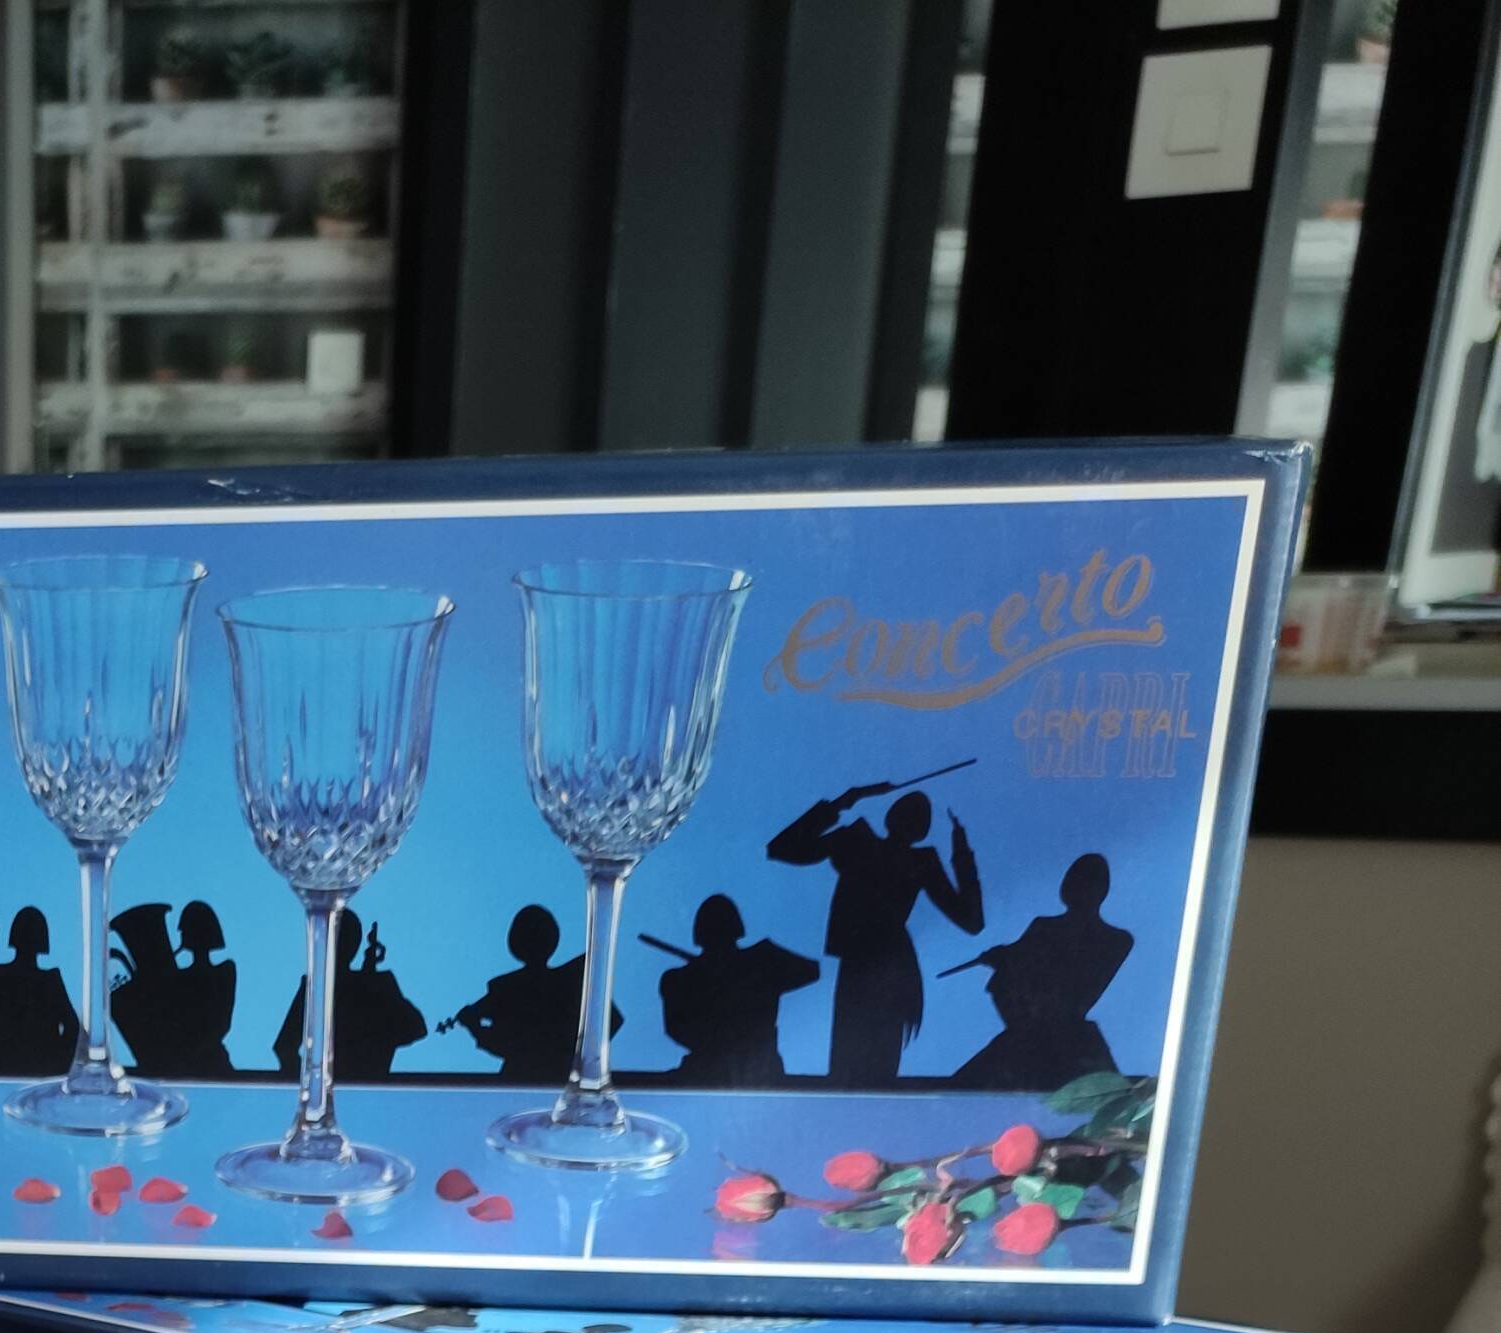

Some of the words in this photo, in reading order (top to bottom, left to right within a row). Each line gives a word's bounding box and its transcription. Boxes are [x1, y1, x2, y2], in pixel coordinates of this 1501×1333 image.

[761, 548, 1161, 700] Concerto
[1013, 707, 1197, 740] CRYSTAL
[1026, 671, 1190, 778] CAPRI
